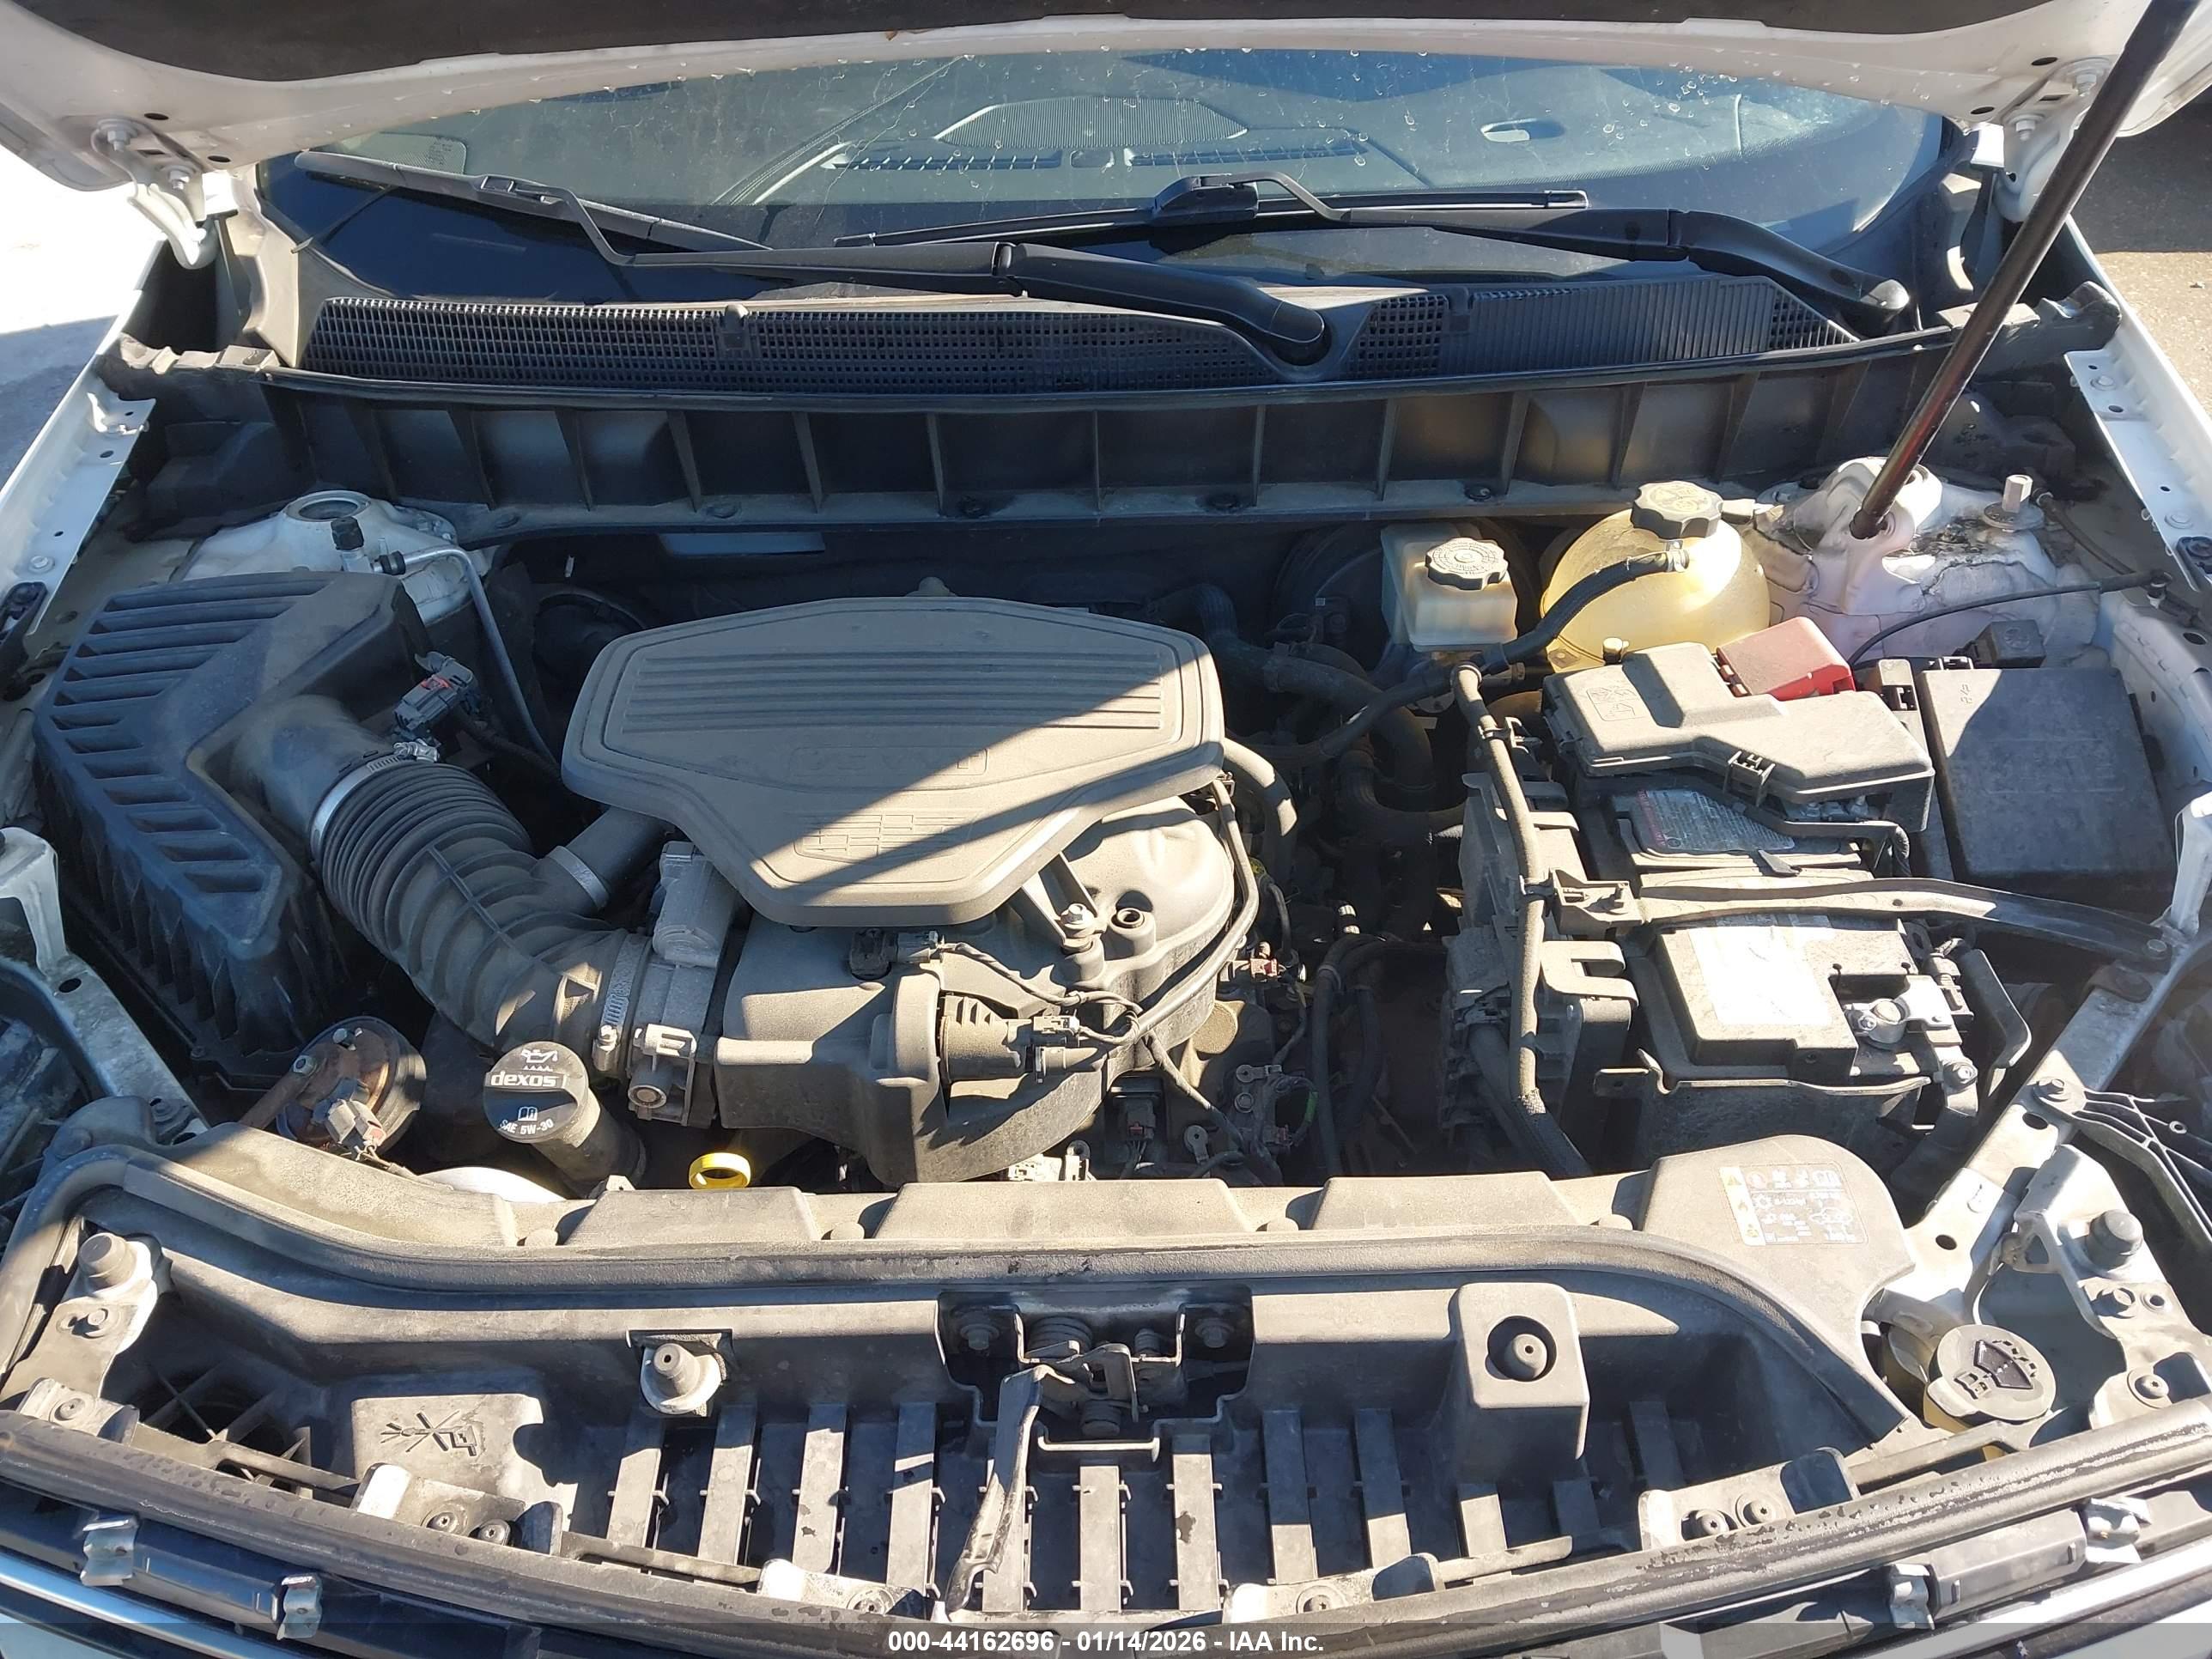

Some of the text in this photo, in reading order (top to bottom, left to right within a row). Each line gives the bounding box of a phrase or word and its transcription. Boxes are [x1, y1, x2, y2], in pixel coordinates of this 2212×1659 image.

[490, 1071, 556, 1087] dexos
[500, 1119, 554, 1134] SAE 5W-30
